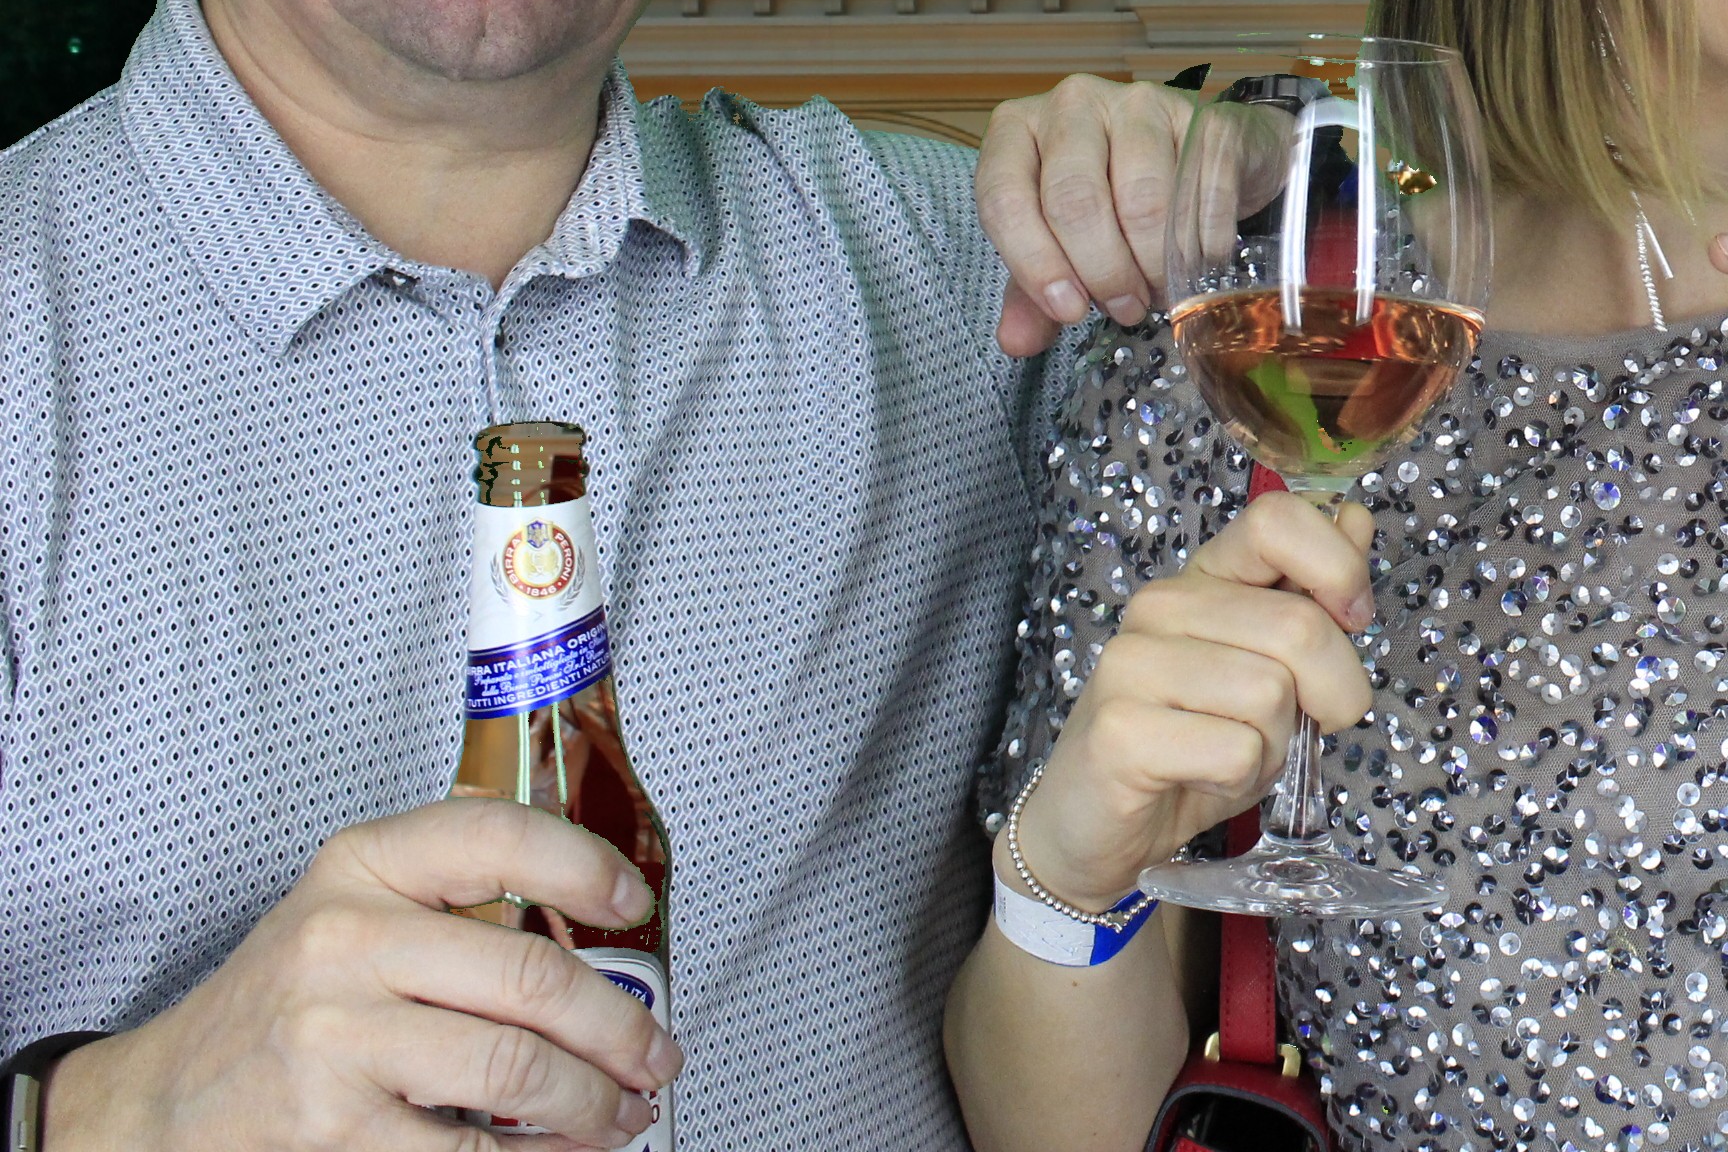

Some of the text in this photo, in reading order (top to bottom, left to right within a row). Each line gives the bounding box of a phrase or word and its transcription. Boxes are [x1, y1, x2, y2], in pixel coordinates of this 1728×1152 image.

[504, 538, 521, 584] BIRRA
[554, 532, 573, 581] PERONI
[526, 585, 557, 597] 1846
[493, 644, 566, 674] ITALIANA
[467, 698, 492, 708] TUTTI
[493, 670, 581, 706] INGREDIENTI
